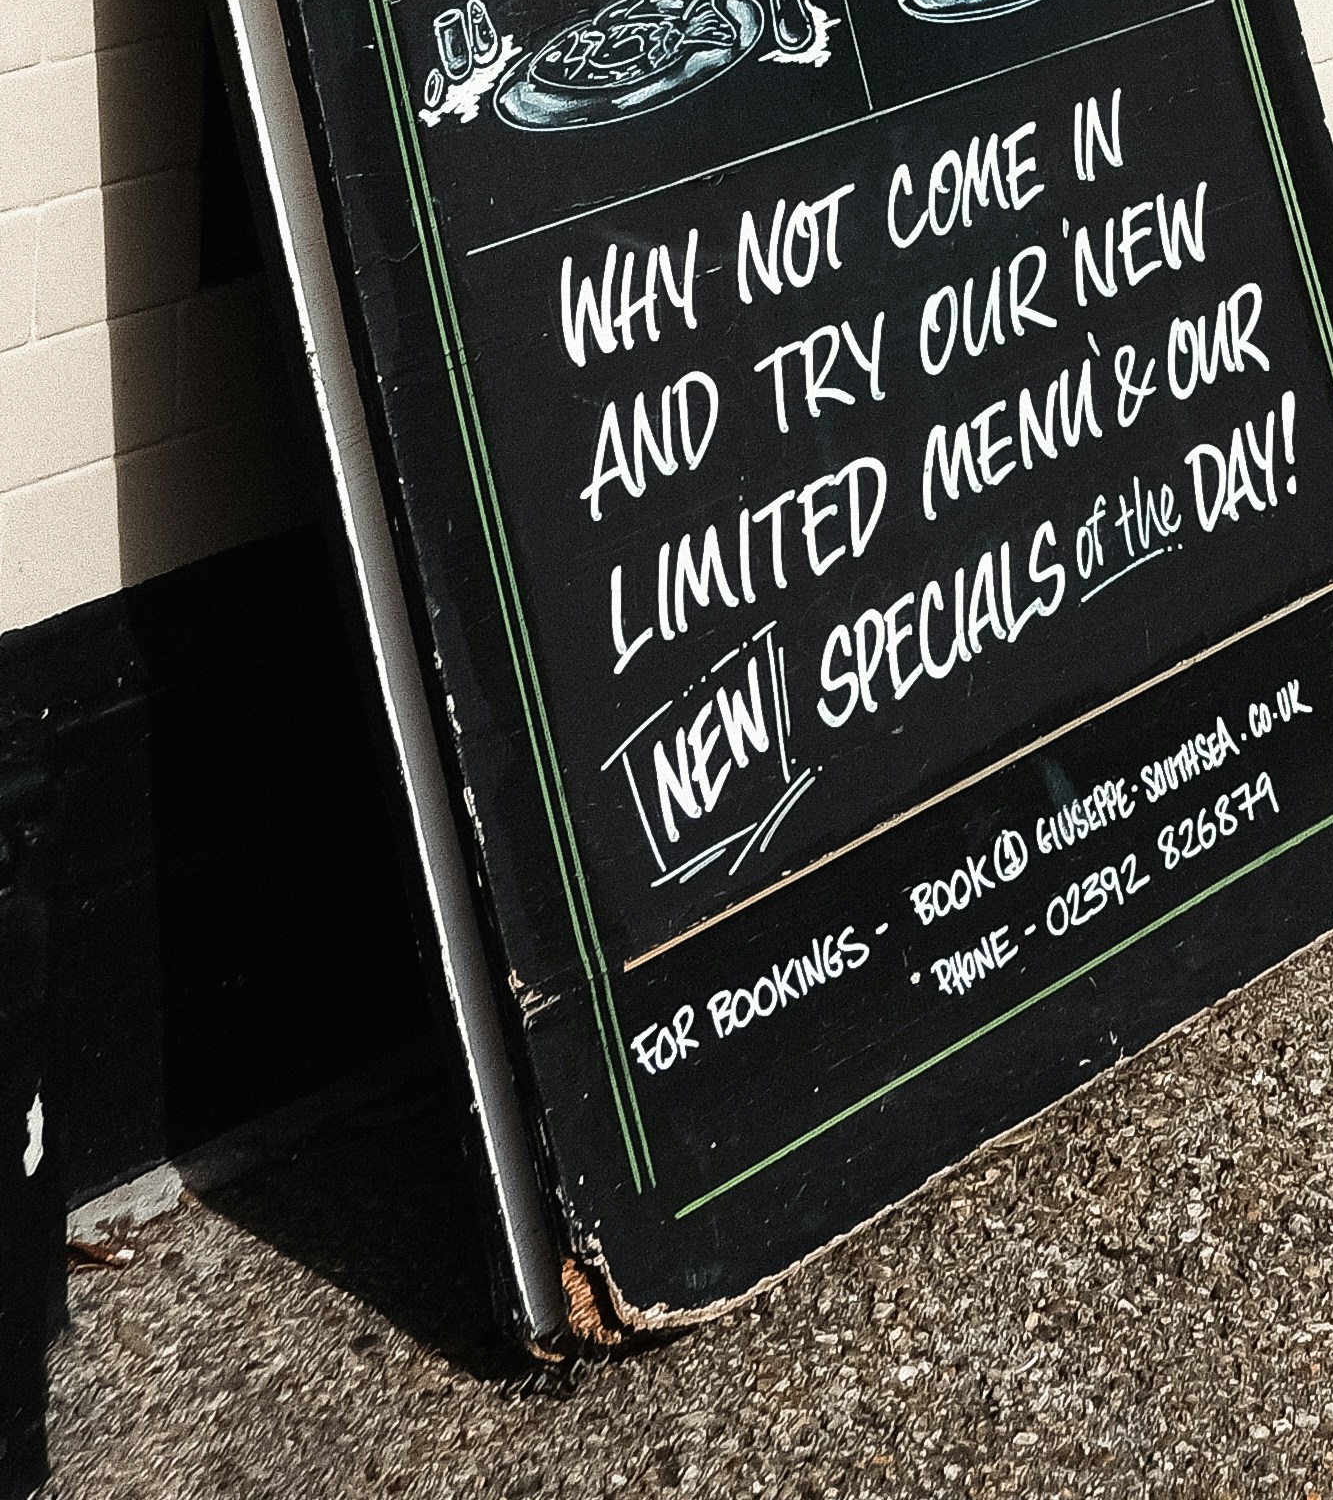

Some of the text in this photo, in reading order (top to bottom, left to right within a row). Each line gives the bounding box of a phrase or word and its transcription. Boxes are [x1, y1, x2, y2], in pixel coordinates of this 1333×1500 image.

[561, 88, 1123, 367] WHY NOT COME IN
[581, 371, 718, 521] AND
[752, 312, 886, 433] TRY
[920, 246, 1057, 375] OUR
[611, 457, 885, 674] LIMITED
[1117, 346, 1156, 427] &
[1168, 283, 1270, 400] OUR
[654, 391, 1296, 840] NEW SPECIALS of the DAY!
[631, 1005, 699, 1074] FOR
[707, 927, 869, 1038] BOOKINGS
[931, 929, 1017, 994] PHONE
[1047, 854, 1150, 935] 02392
[1158, 772, 1279, 869] 826879
